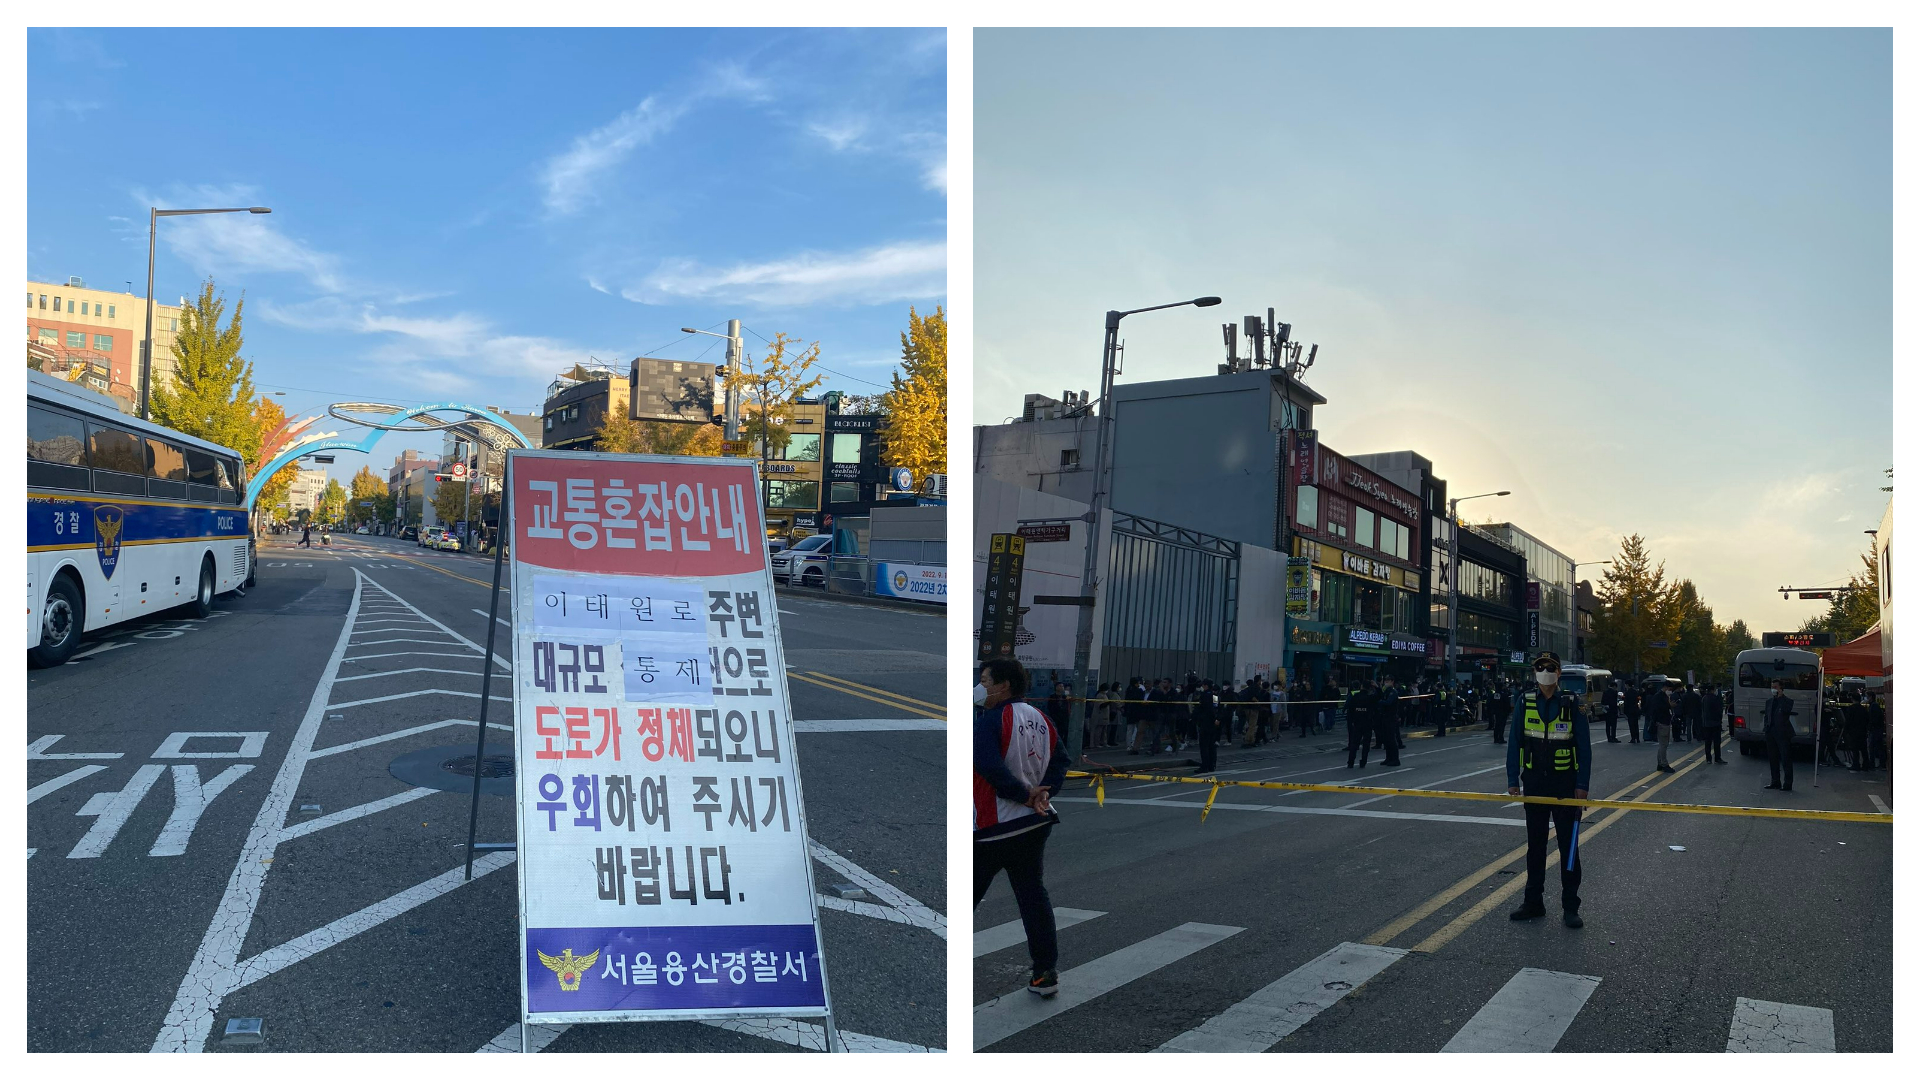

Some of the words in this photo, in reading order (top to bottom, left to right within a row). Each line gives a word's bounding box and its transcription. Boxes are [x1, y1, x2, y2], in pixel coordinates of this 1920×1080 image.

[54, 511, 80, 535] 경찰
[217, 515, 234, 530] POLICE
[527, 478, 750, 554] 교통혼잡안내
[102, 557, 115, 566] POLICE
[993, 555, 1000, 566] 4
[1011, 557, 1019, 568] 4
[1349, 555, 1371, 575] 이바돔
[910, 580, 936, 595] 2022년
[987, 575, 999, 614] 이태원
[1006, 576, 1017, 616] 이태원
[708, 590, 764, 639] 주변
[1369, 632, 1385, 643] KEBAB
[1391, 639, 1407, 650] EDIYA
[1407, 641, 1425, 652] COFFEE
[532, 641, 608, 693] 대규모
[633, 656, 700, 685] 통제
[535, 705, 622, 761] 도로가
[637, 707, 781, 764] 정체되오니
[536, 773, 671, 832] 우회하여
[692, 775, 791, 833] 주시기
[595, 845, 745, 905] 바랍니다.
[601, 950, 808, 986] 서울용산경찰서
